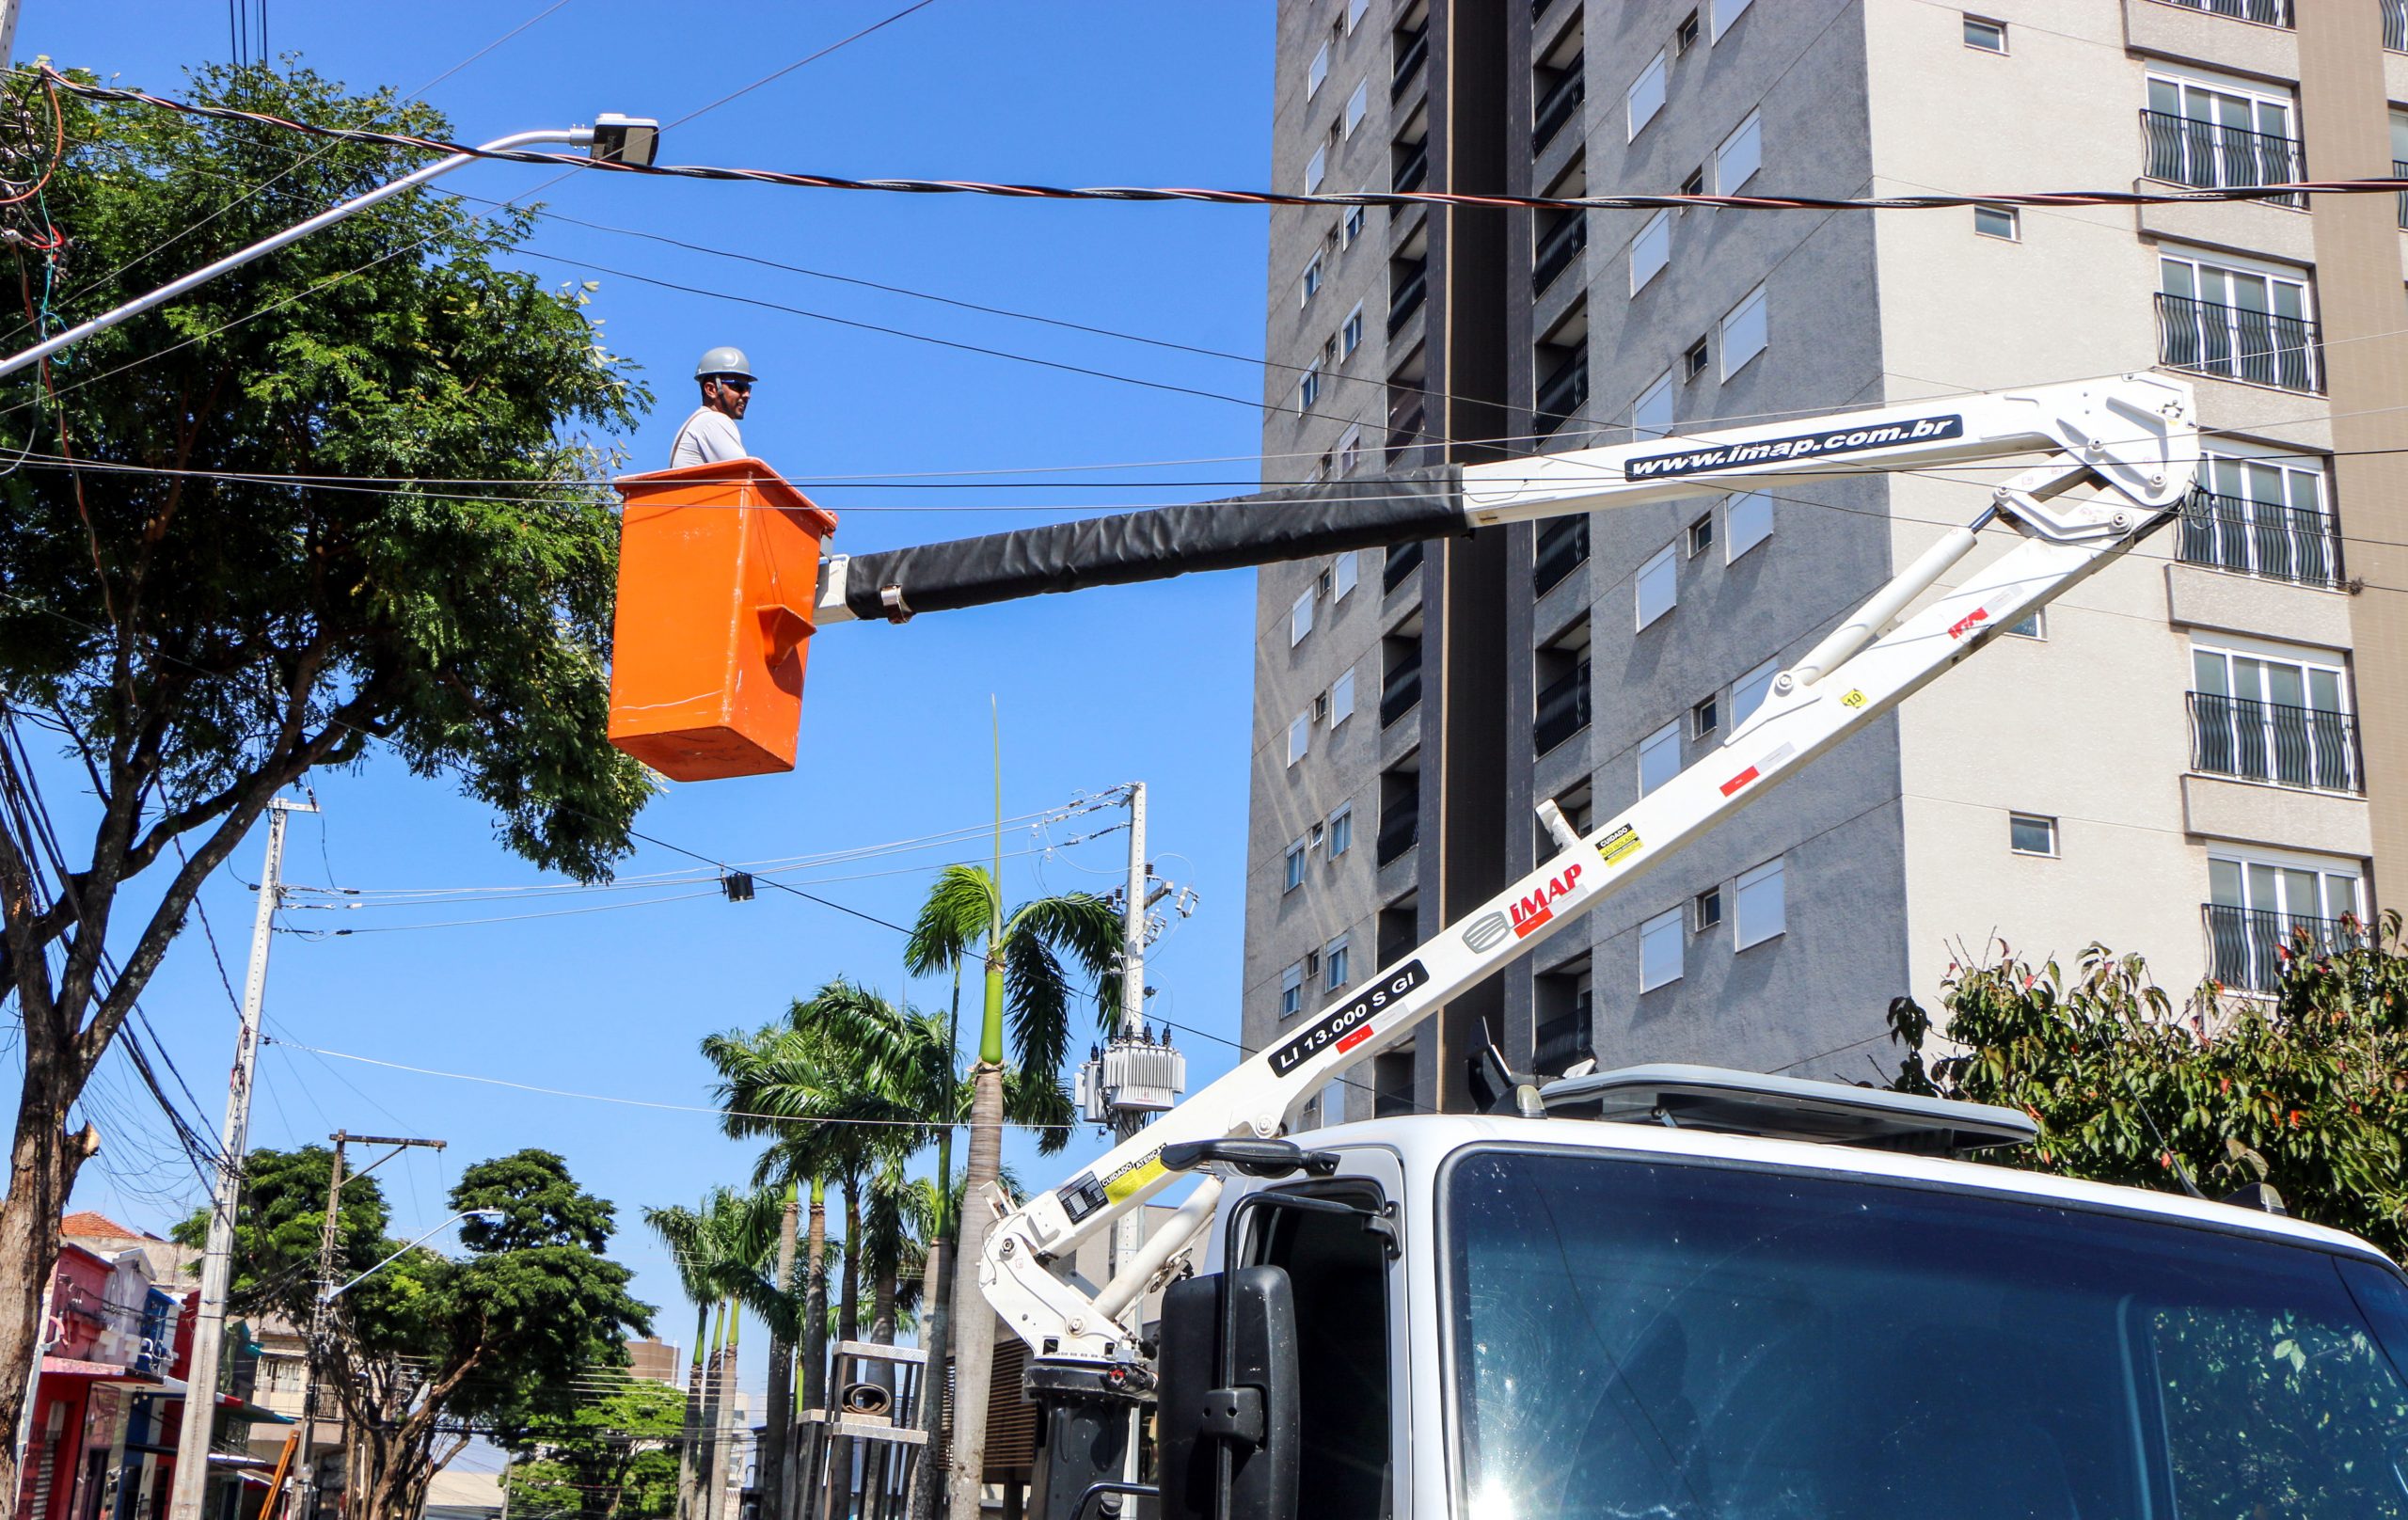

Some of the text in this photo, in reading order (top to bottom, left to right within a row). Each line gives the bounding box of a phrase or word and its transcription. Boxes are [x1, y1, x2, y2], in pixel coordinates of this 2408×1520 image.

[1633, 419, 1953, 475] www.imap.com.br
[1600, 827, 1628, 847] CUIDADO
[1280, 1046, 1299, 1069] LI
[1305, 1004, 1367, 1051] 13.000
[1372, 990, 1386, 1007] S
[1391, 972, 1414, 994] GI
[1101, 1163, 1133, 1187] CUIDADO
